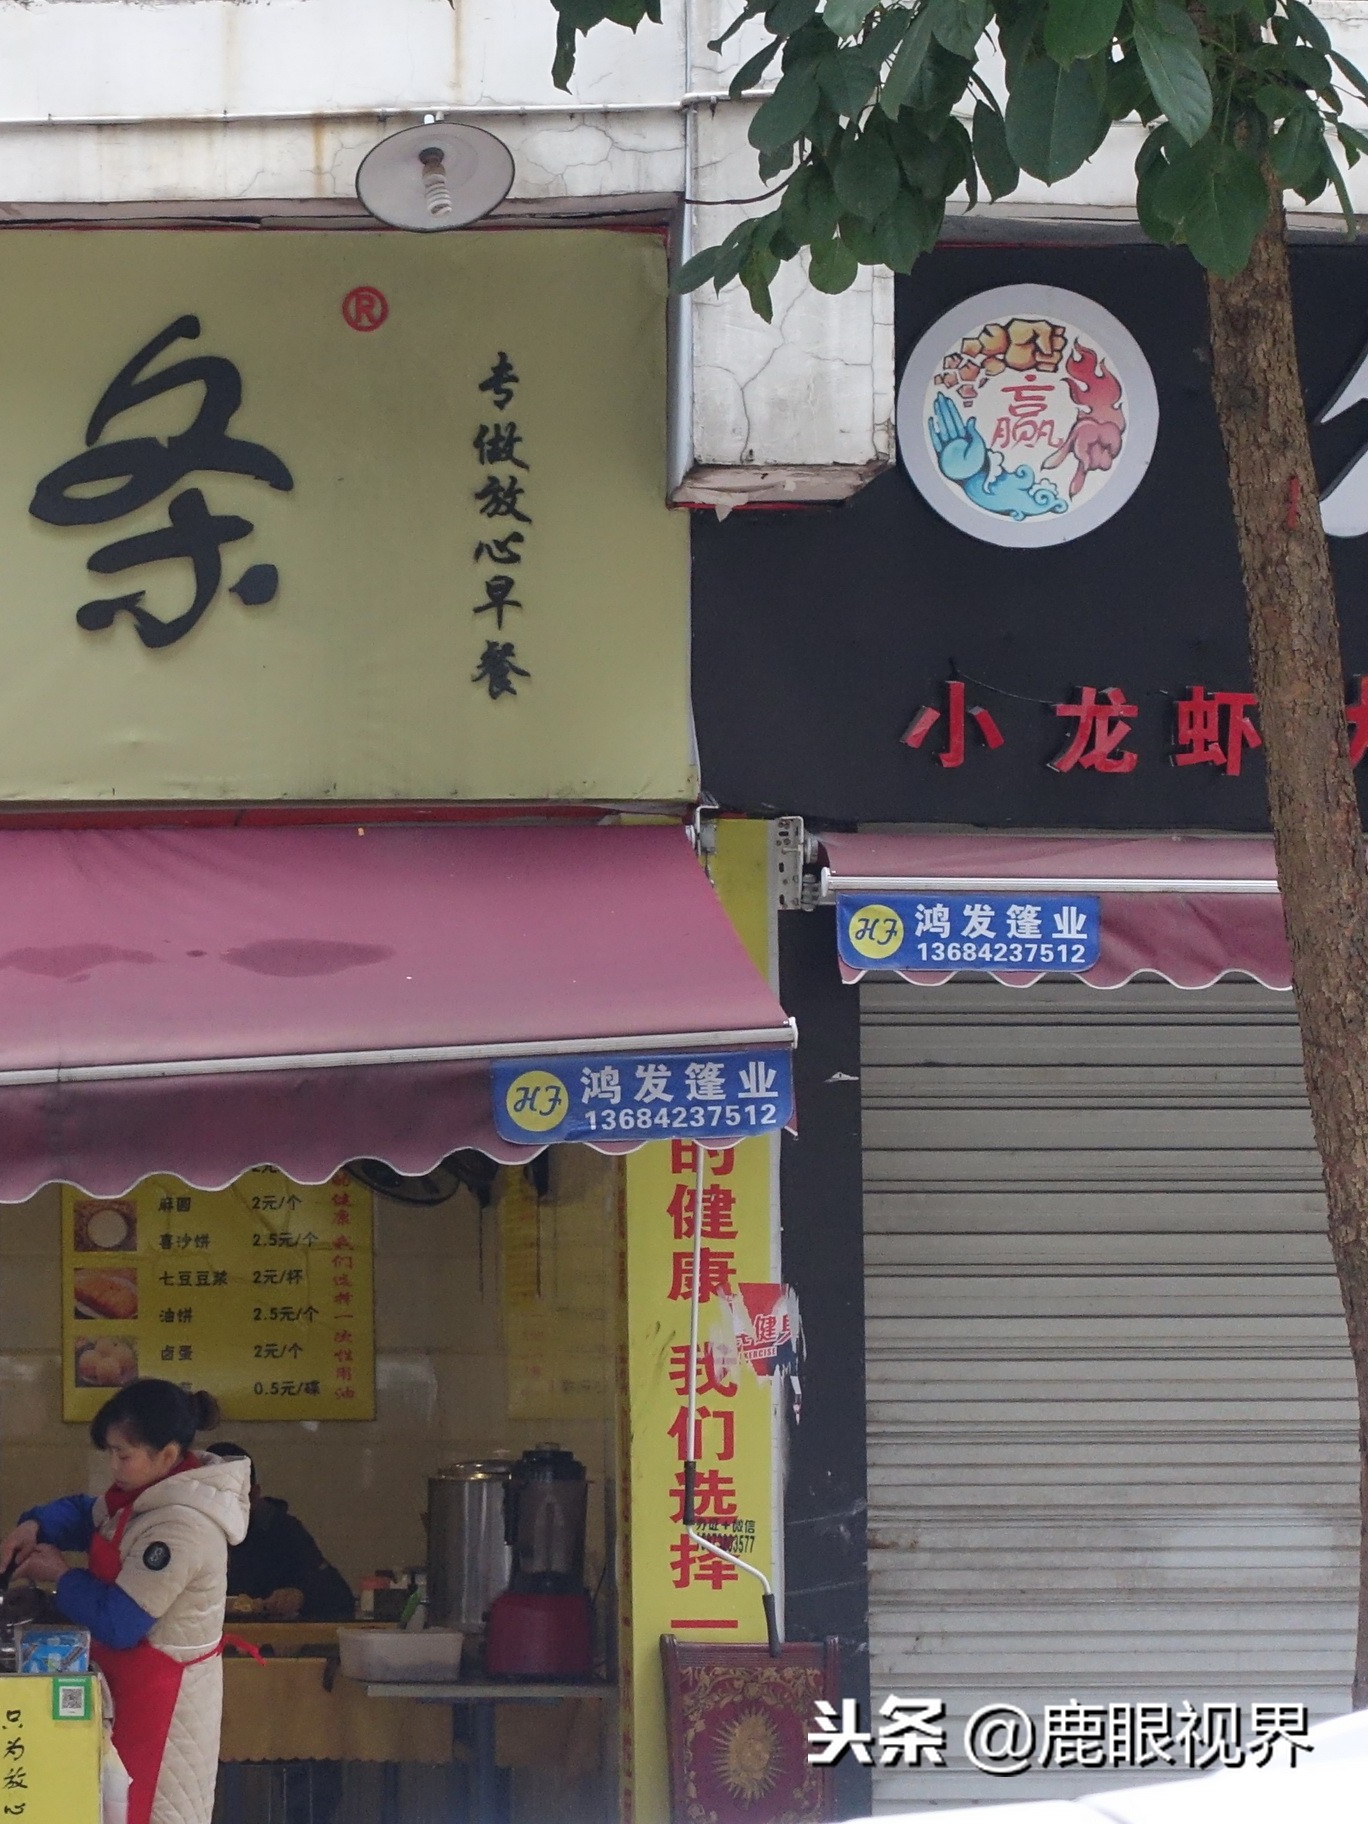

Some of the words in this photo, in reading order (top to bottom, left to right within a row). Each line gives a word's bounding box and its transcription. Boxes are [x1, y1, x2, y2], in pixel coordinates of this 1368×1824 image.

[471, 351, 532, 700] 专做放心早餐
[899, 674, 1368, 777] 小龙虾
[914, 902, 1088, 940] 鸿发篷业
[917, 943, 1086, 964] 13684237512
[580, 1061, 780, 1104] 鸿发篷业
[585, 1103, 777, 1131] 13684237512
[251, 1195, 302, 1211] 2元/个
[252, 1232, 319, 1248] 2.5元/个
[252, 1269, 304, 1285] 2元/杯
[159, 1307, 193, 1323] 油饼
[253, 1305, 319, 1322] 2.5元/个
[161, 1344, 193, 1361] 卤蛋
[253, 1342, 303, 1359] 2元/个
[2, 1710, 29, 1816] 只为放心
